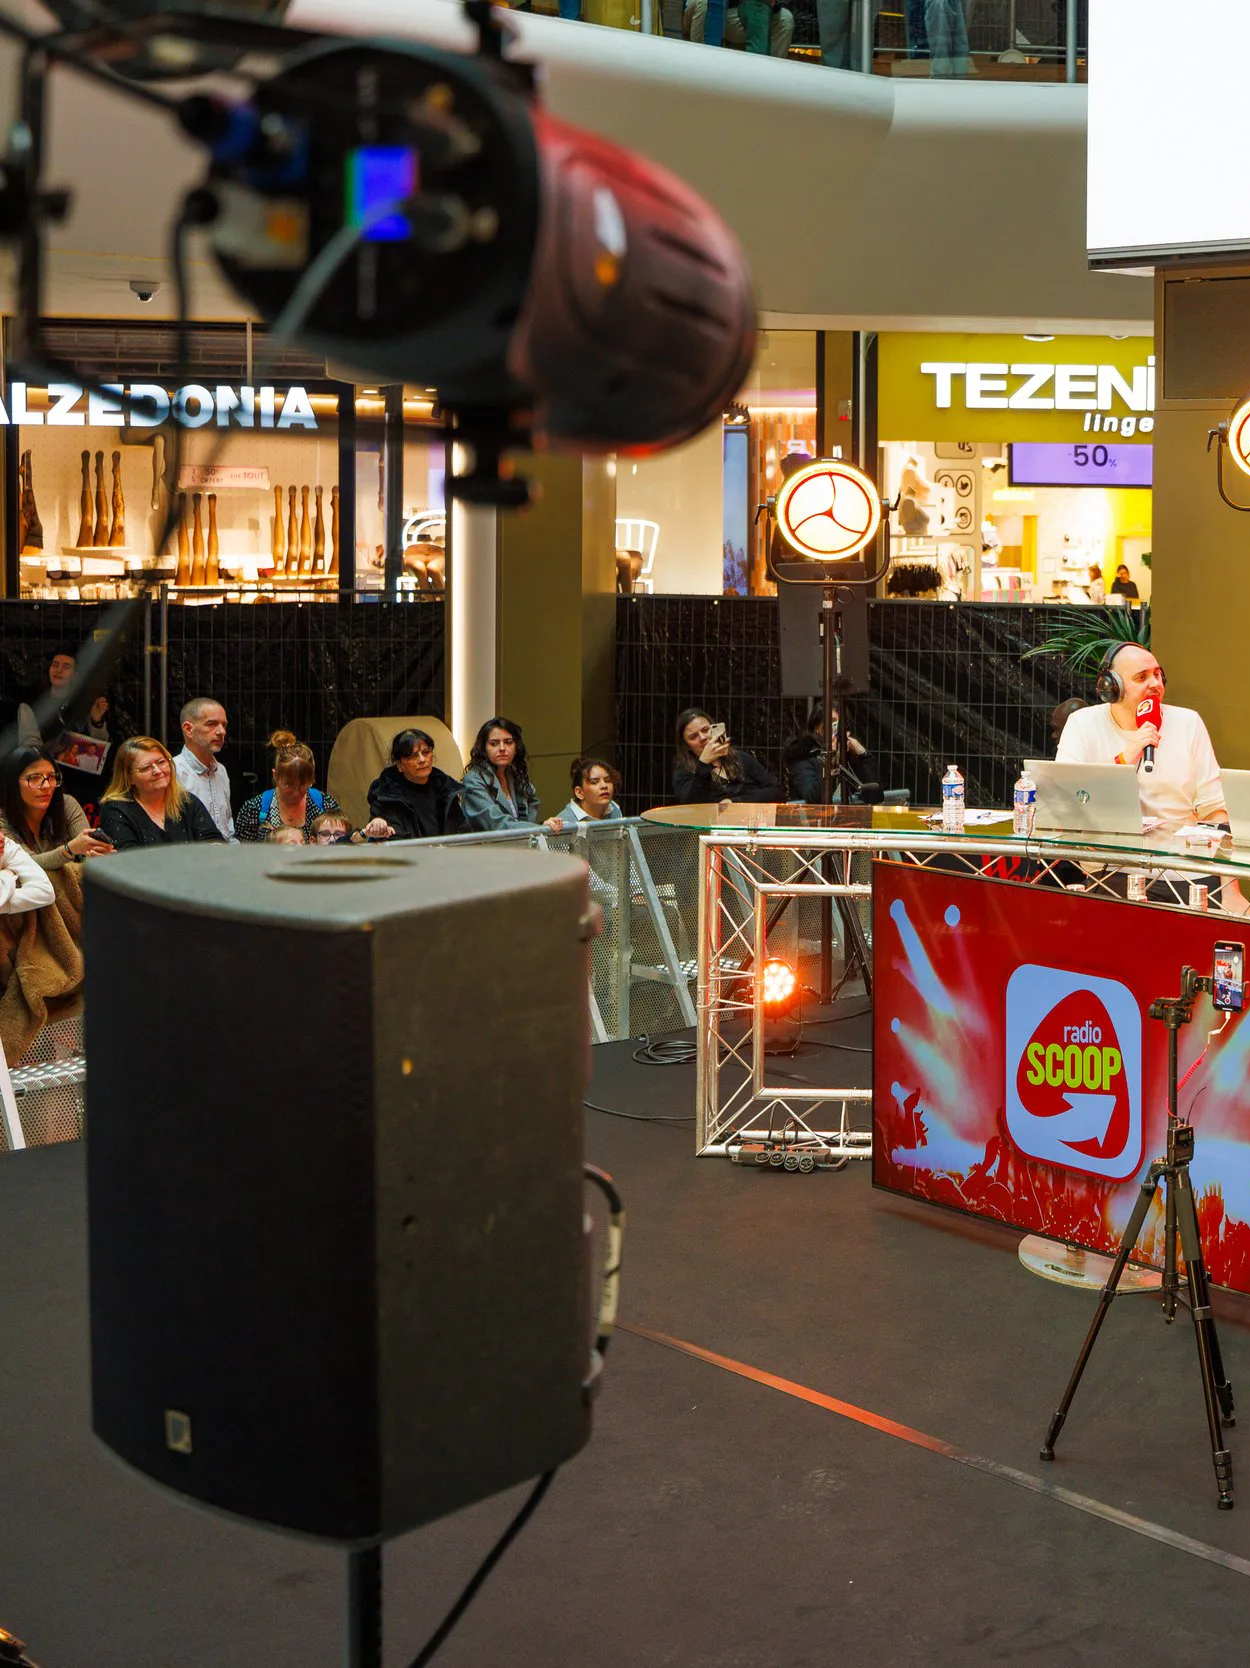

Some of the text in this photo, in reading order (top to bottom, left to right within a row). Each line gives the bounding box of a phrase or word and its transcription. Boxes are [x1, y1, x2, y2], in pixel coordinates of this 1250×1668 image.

[0, 382, 318, 429] LZEDONIA
[1063, 1020, 1103, 1043] radio
[1026, 1042, 1121, 1091] SCOOP
